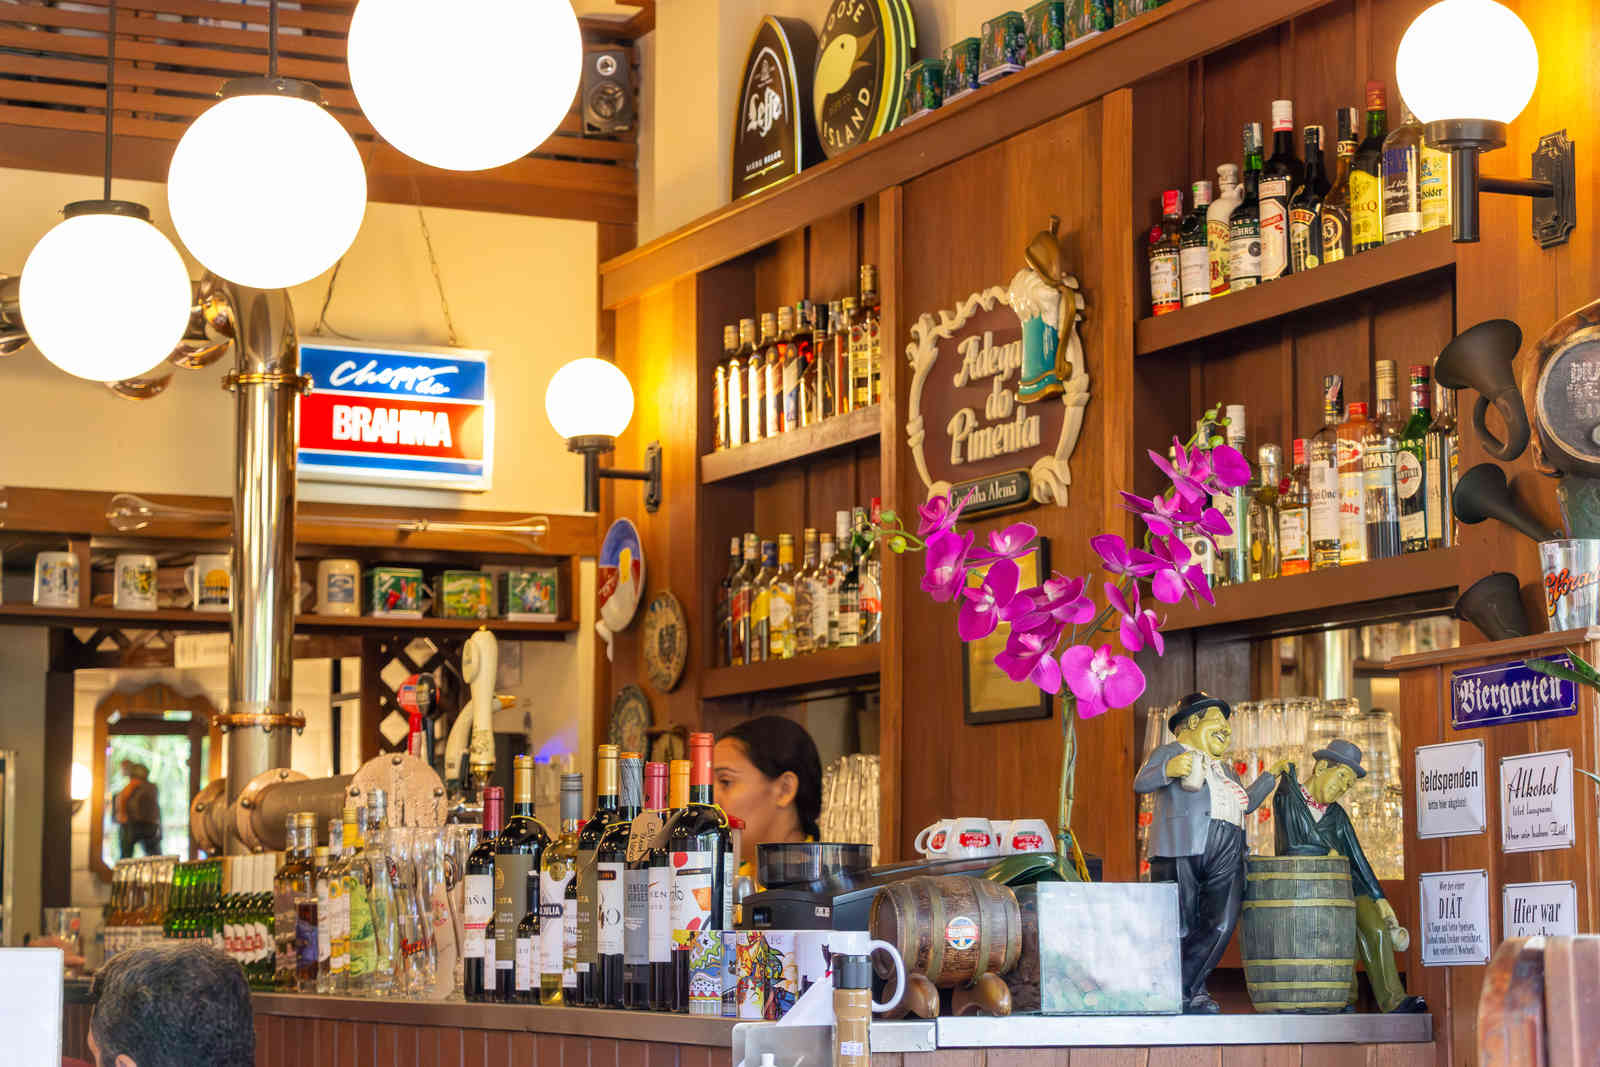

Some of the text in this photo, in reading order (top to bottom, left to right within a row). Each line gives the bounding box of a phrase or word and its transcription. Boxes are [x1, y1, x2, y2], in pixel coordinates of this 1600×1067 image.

[747, 86, 783, 137] Leffe
[822, 88, 871, 148] ISLAND
[332, 404, 453, 448] BRAHMA
[947, 405, 1040, 464] Pimenta
[1457, 675, 1561, 716] Biergarten
[1420, 766, 1478, 794] Geldspenden
[1507, 766, 1559, 803] Alkohol
[1439, 893, 1463, 919] DIÄT
[1513, 897, 1561, 924] Hier war
